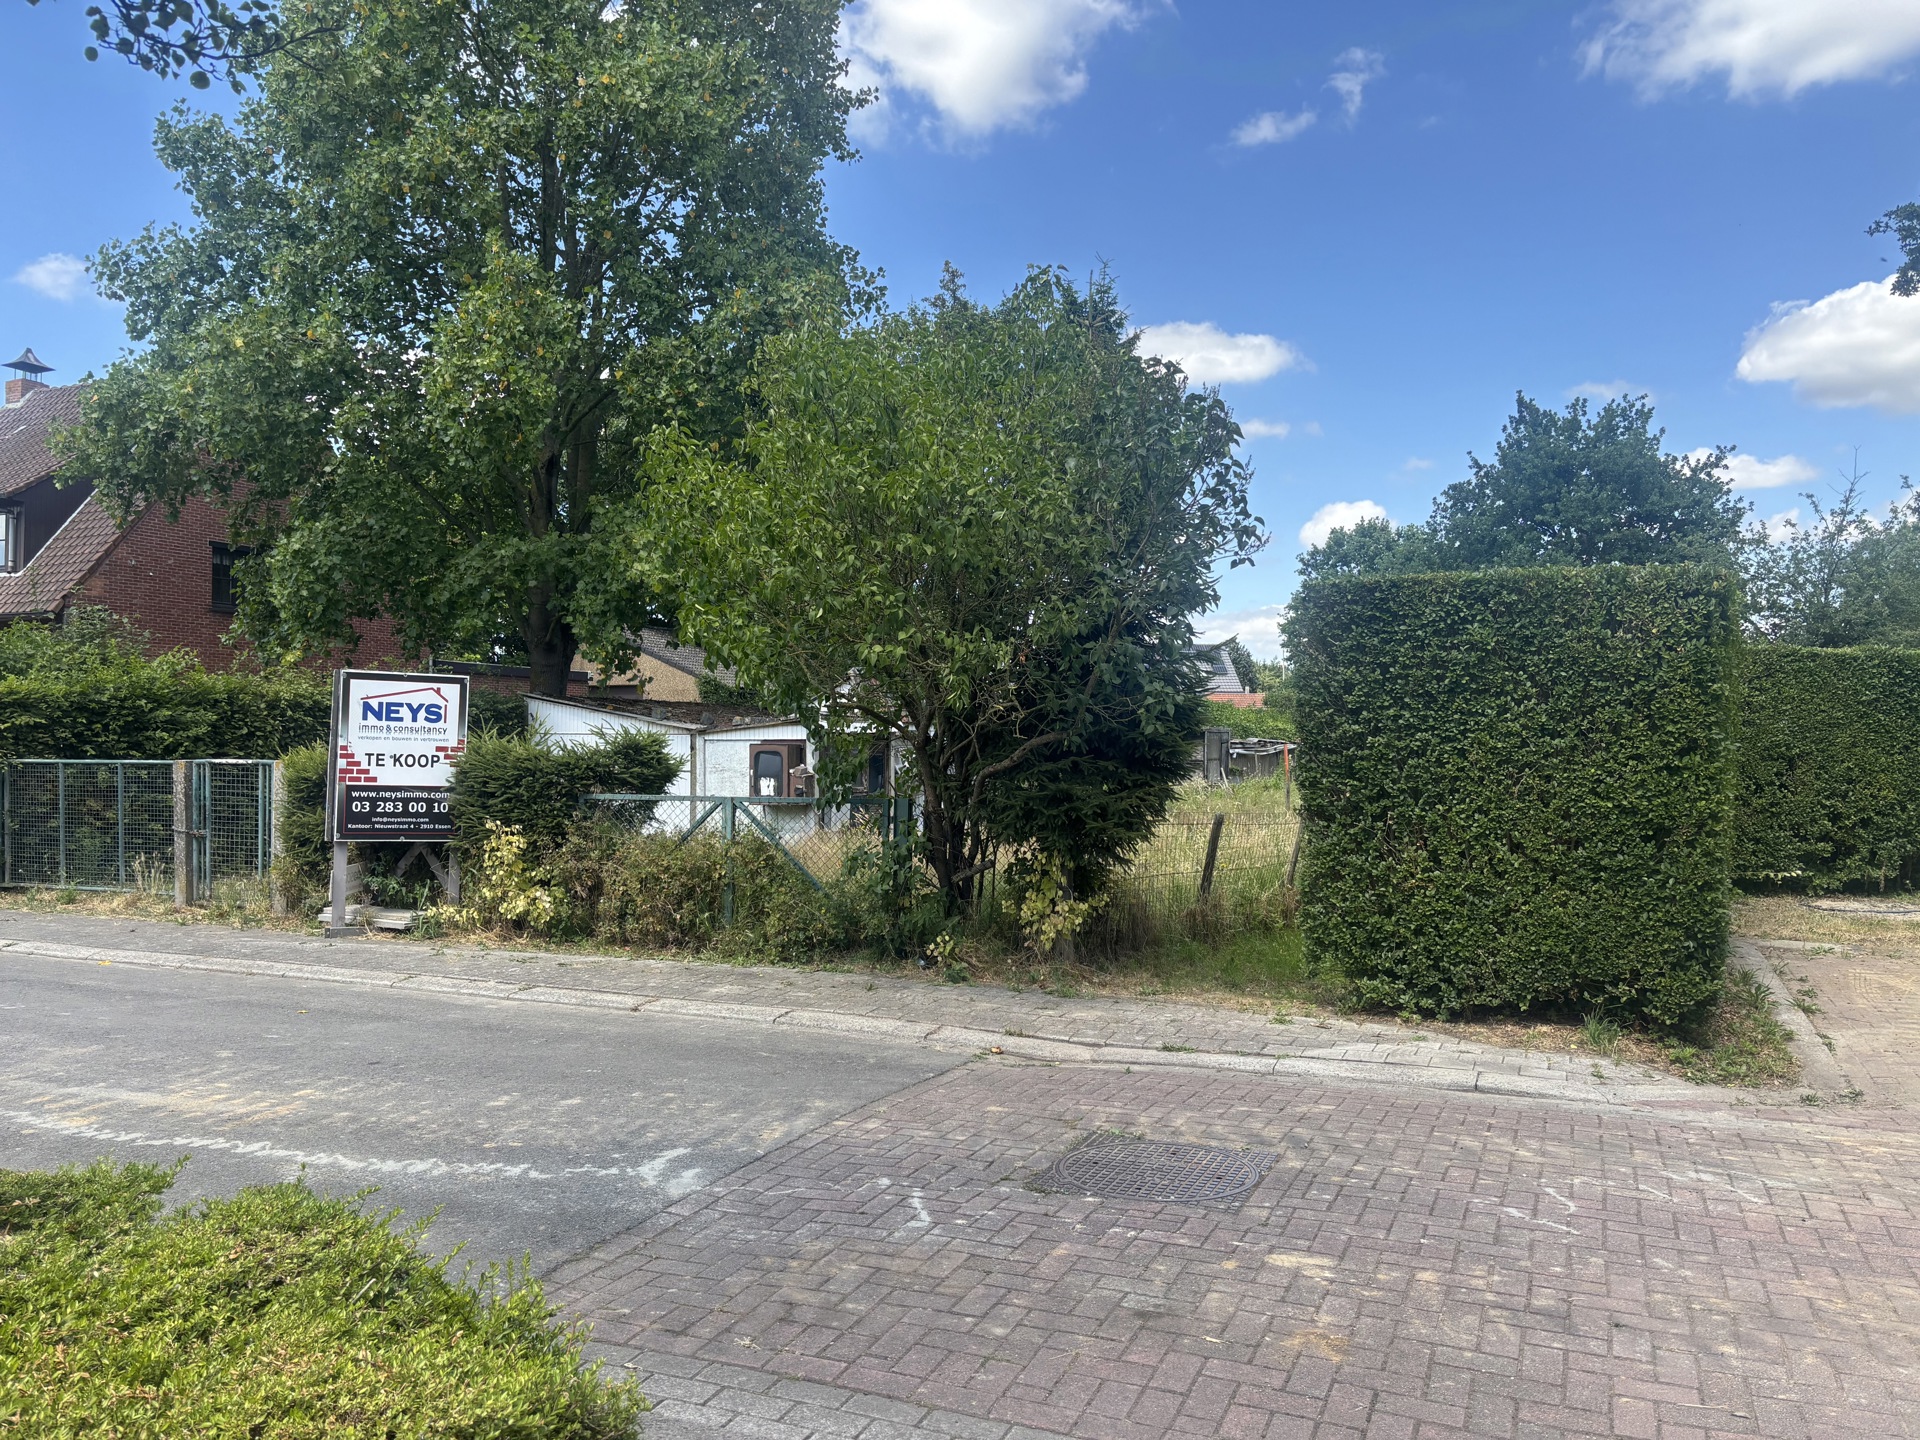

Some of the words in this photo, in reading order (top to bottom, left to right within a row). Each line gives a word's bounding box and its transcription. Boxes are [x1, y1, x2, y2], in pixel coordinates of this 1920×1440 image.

[362, 701, 442, 723] NEYS
[394, 725, 447, 734] consultancy
[365, 753, 385, 767] TE
[393, 754, 440, 768] KOOP
[352, 790, 449, 799] www.neysimmo.com
[352, 802, 370, 812] 03
[376, 802, 402, 812] 283
[409, 802, 426, 812] 00
[433, 802, 448, 812] 10
